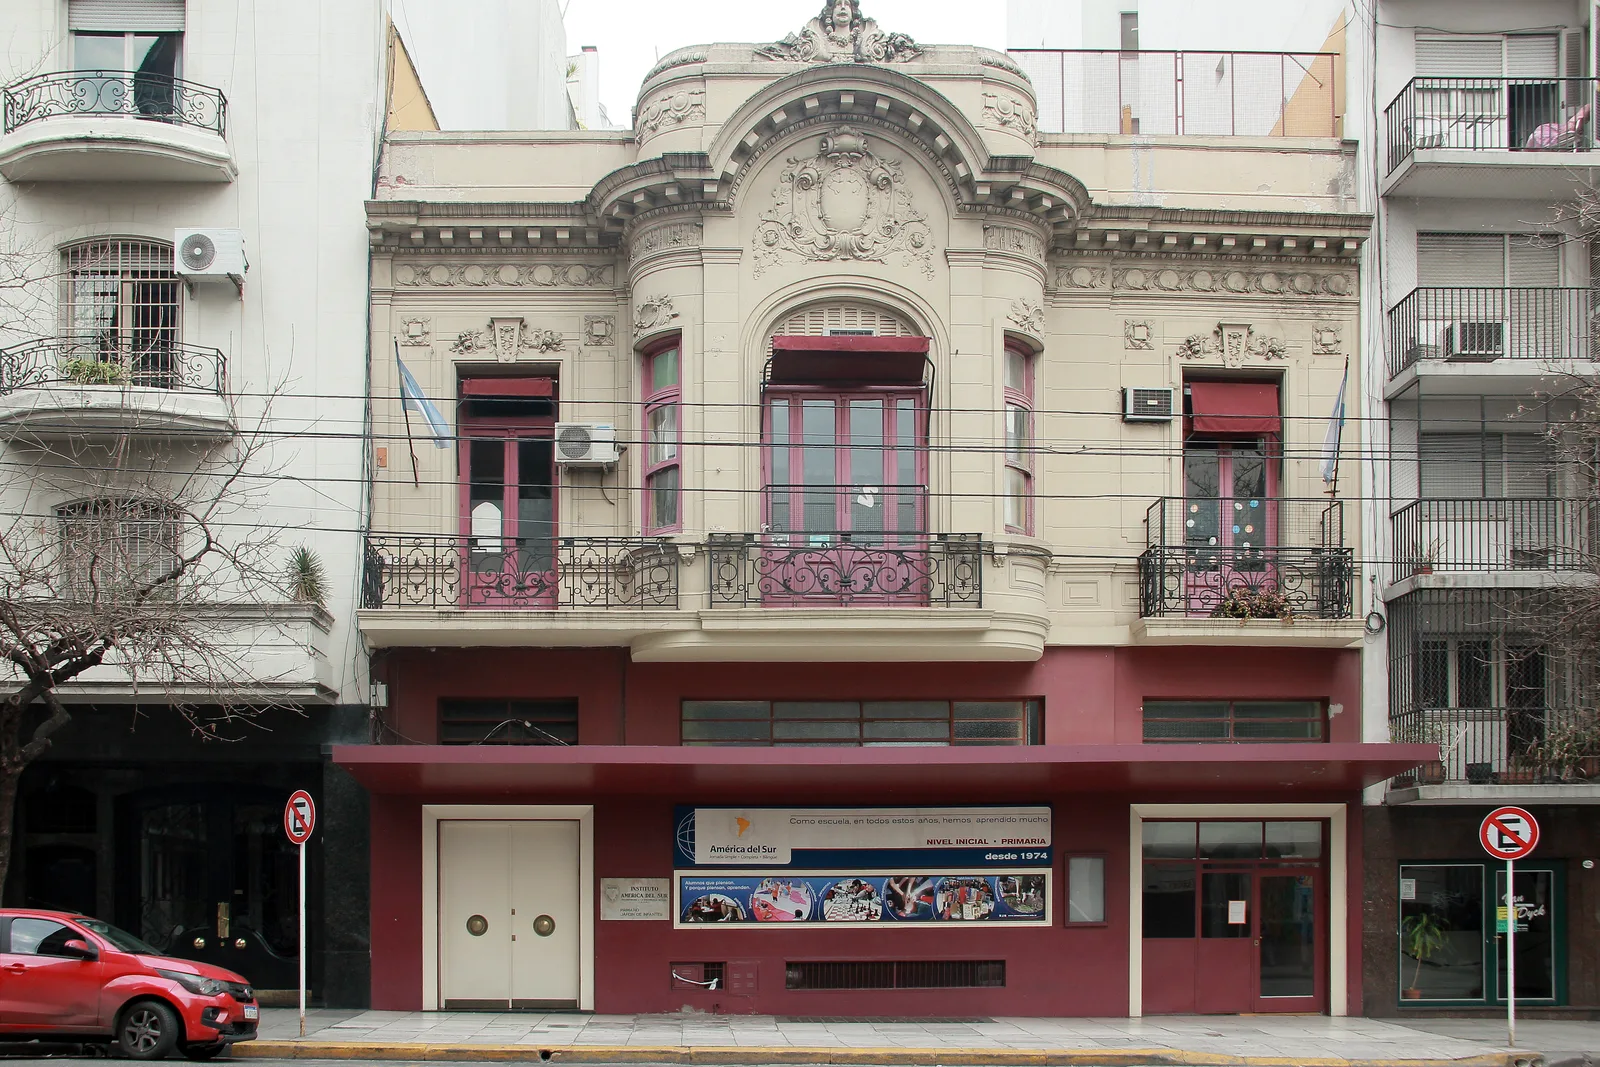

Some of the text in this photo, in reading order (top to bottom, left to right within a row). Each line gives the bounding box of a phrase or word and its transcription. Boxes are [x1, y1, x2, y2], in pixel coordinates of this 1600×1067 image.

[789, 817, 815, 825] Como
[866, 817, 889, 825] todos
[942, 816, 972, 824] hemos
[975, 816, 1017, 824] aprendido
[1497, 818, 1521, 848] E
[710, 845, 777, 853] América del Sur
[984, 852, 1048, 860] desde 1974
[1517, 904, 1546, 920] Dyck
